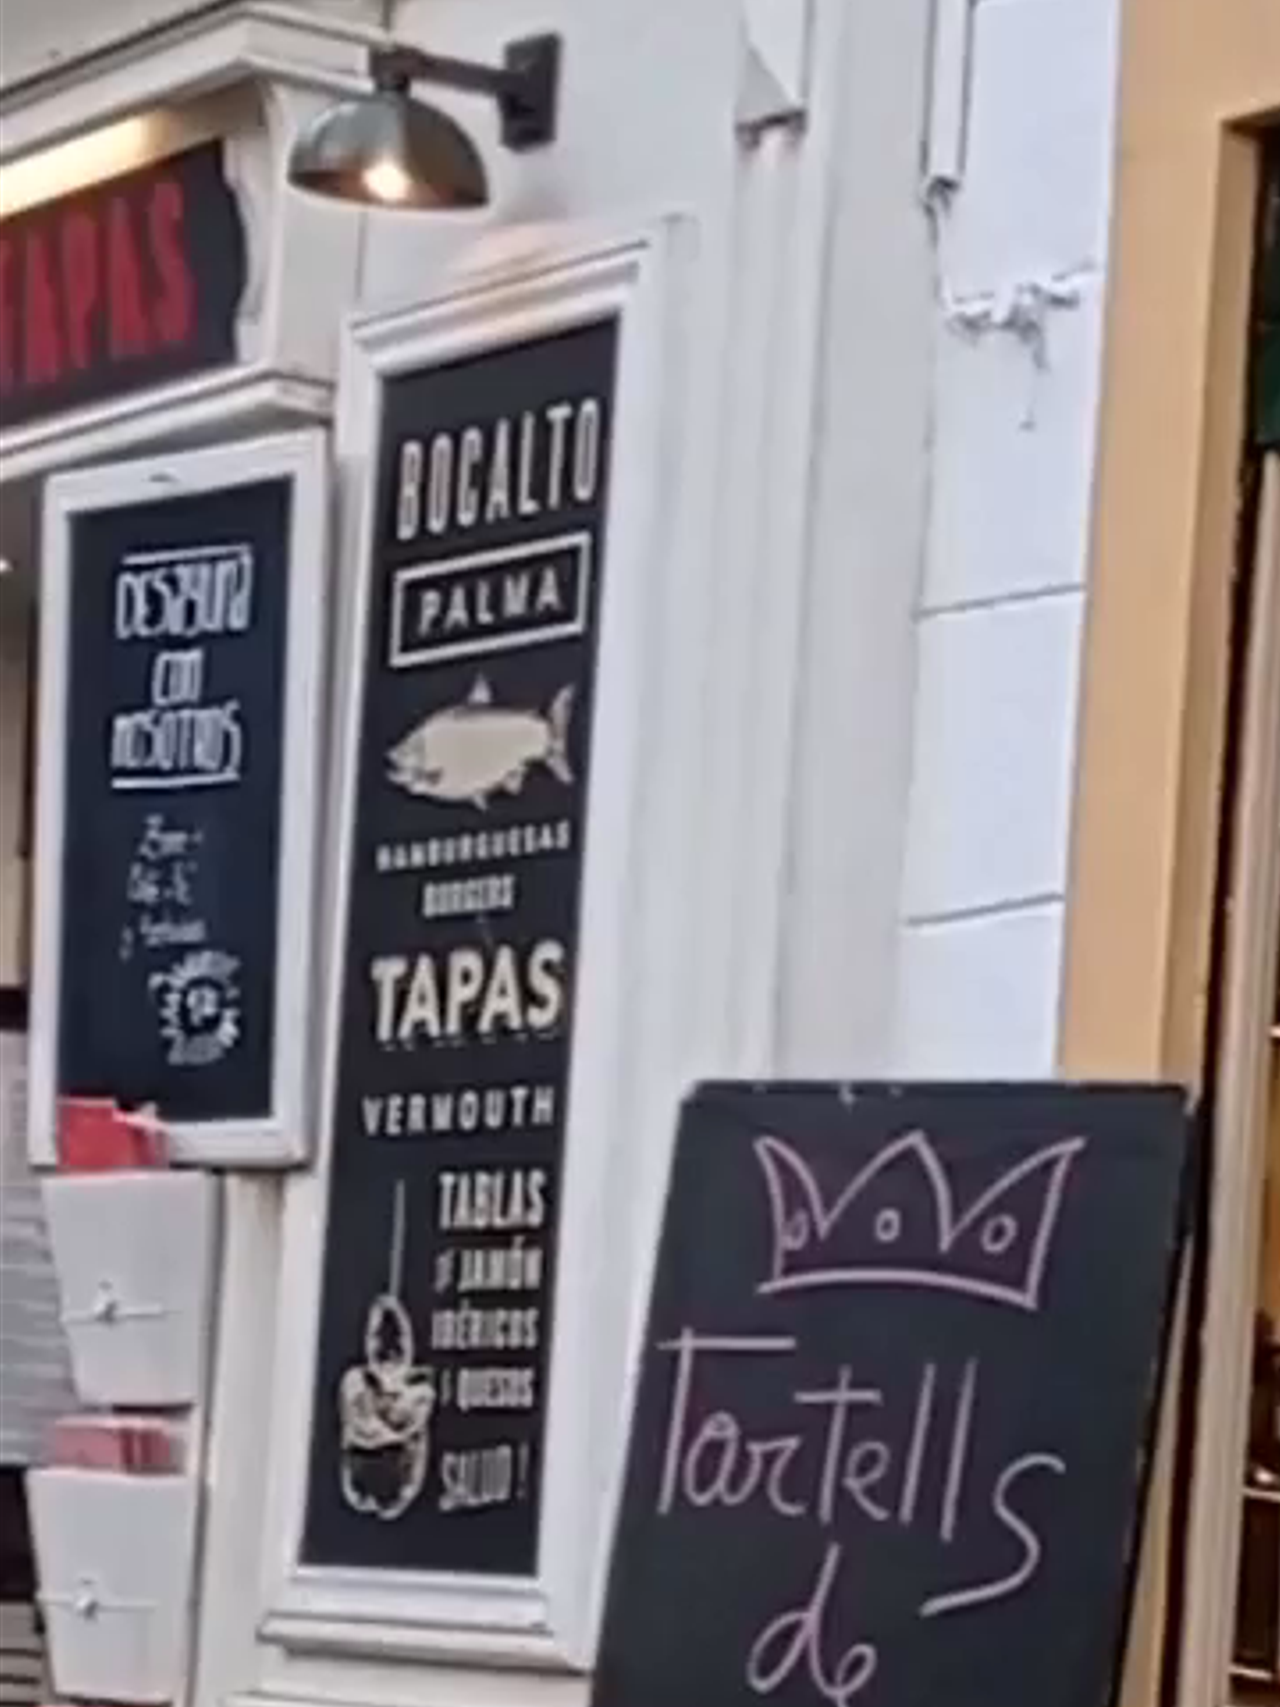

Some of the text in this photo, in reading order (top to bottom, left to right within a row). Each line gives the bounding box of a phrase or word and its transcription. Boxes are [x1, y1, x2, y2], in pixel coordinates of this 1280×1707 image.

[397, 398, 600, 540] BOCALTO
[419, 568, 562, 635] PALMA
[371, 939, 564, 1042] TAPAS
[362, 1087, 555, 1136] VERMOUTH
[438, 1169, 546, 1231] TABLAS
